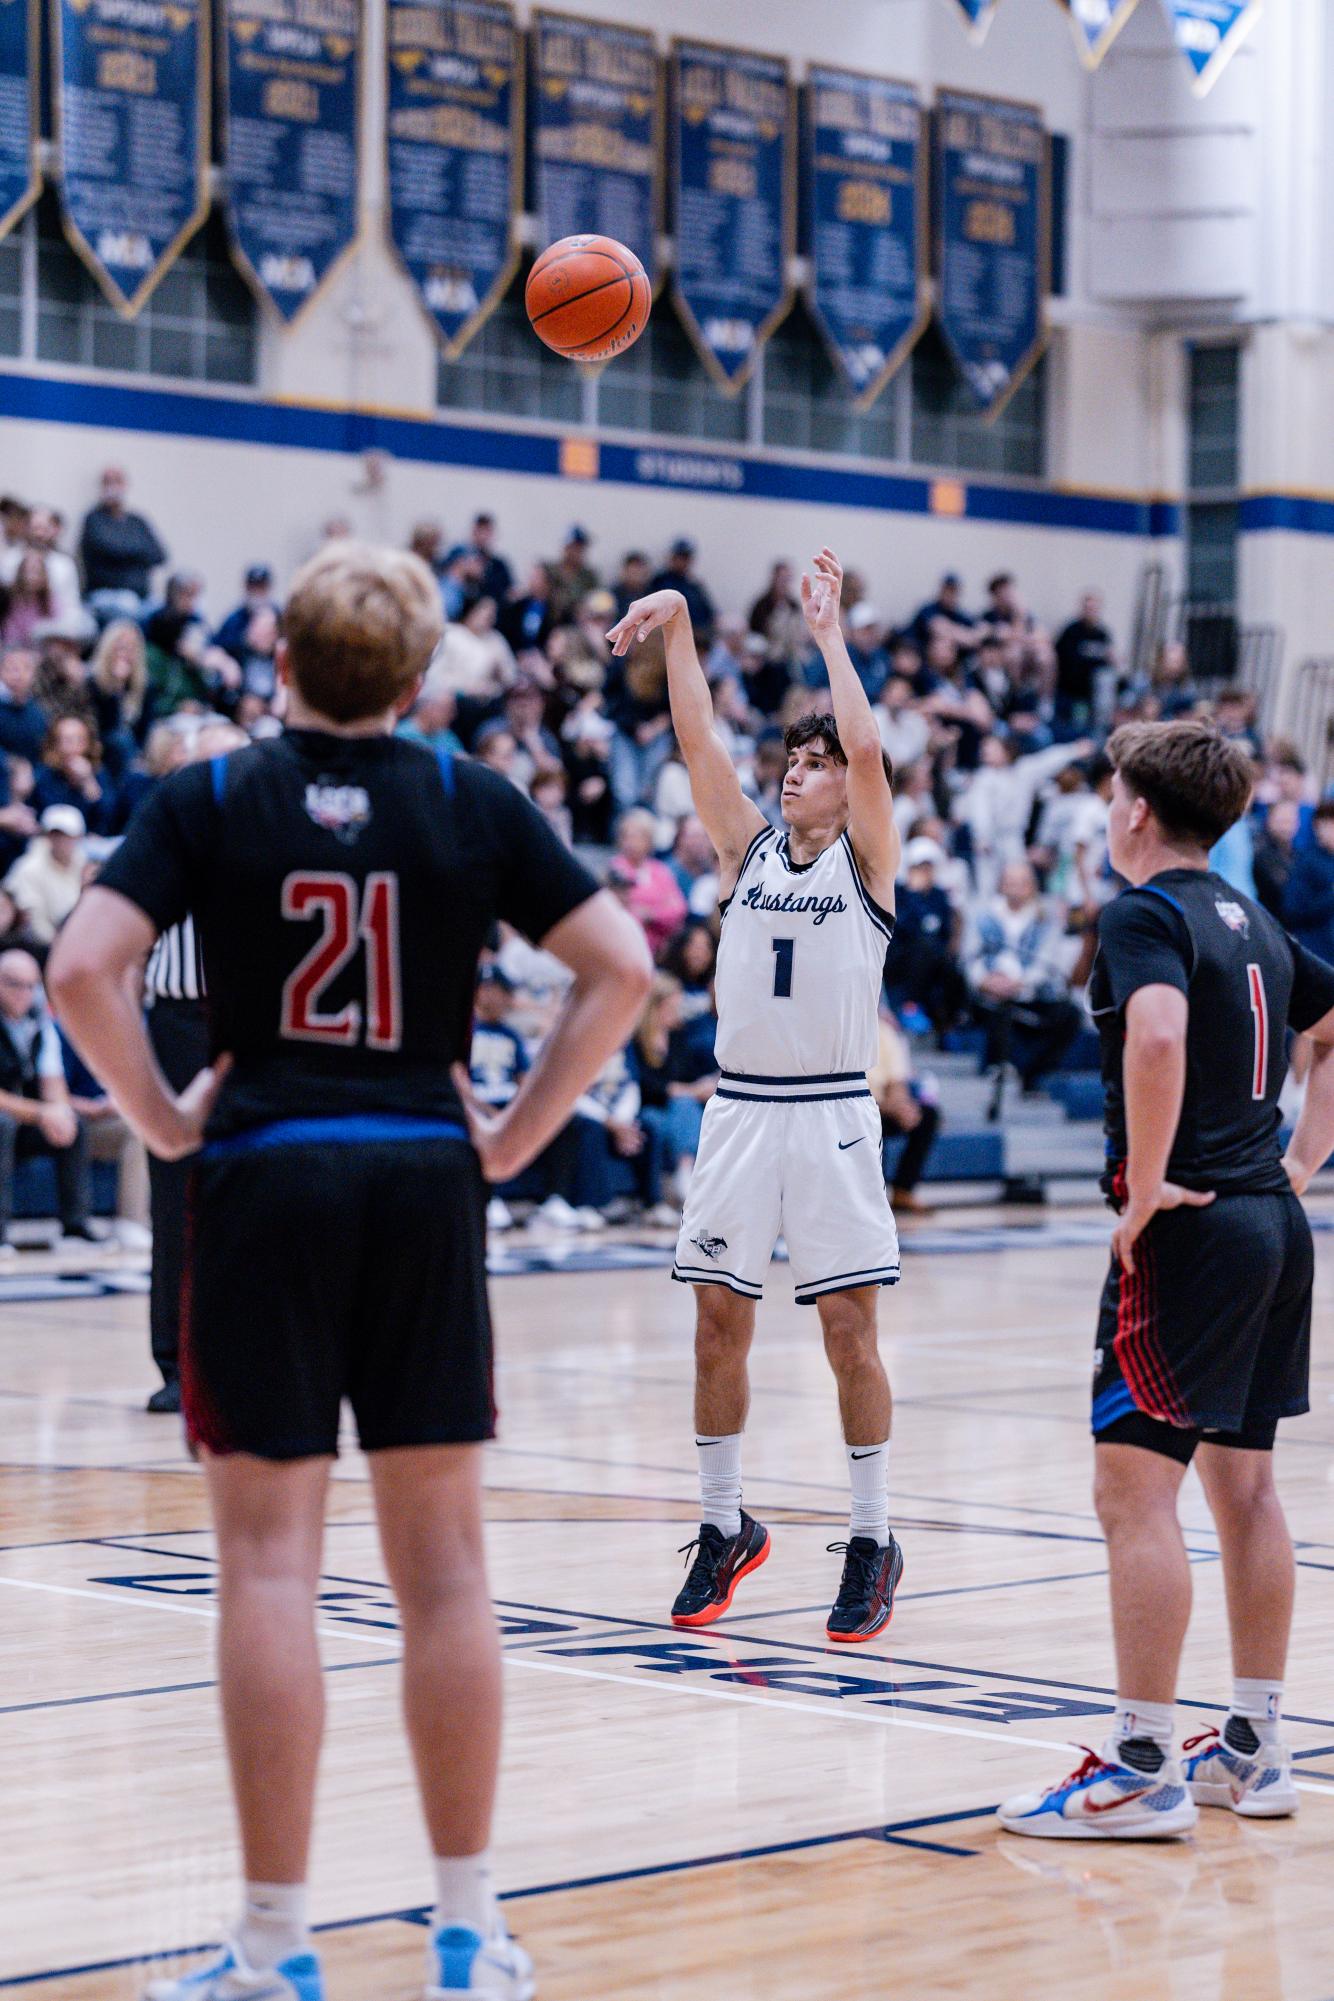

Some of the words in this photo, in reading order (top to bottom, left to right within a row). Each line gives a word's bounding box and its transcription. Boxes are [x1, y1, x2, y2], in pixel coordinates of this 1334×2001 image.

[741, 881, 847, 925] Mustangs
[280, 870, 401, 1051] 21
[771, 936, 796, 999] 1
[1247, 963, 1268, 1100] 1
